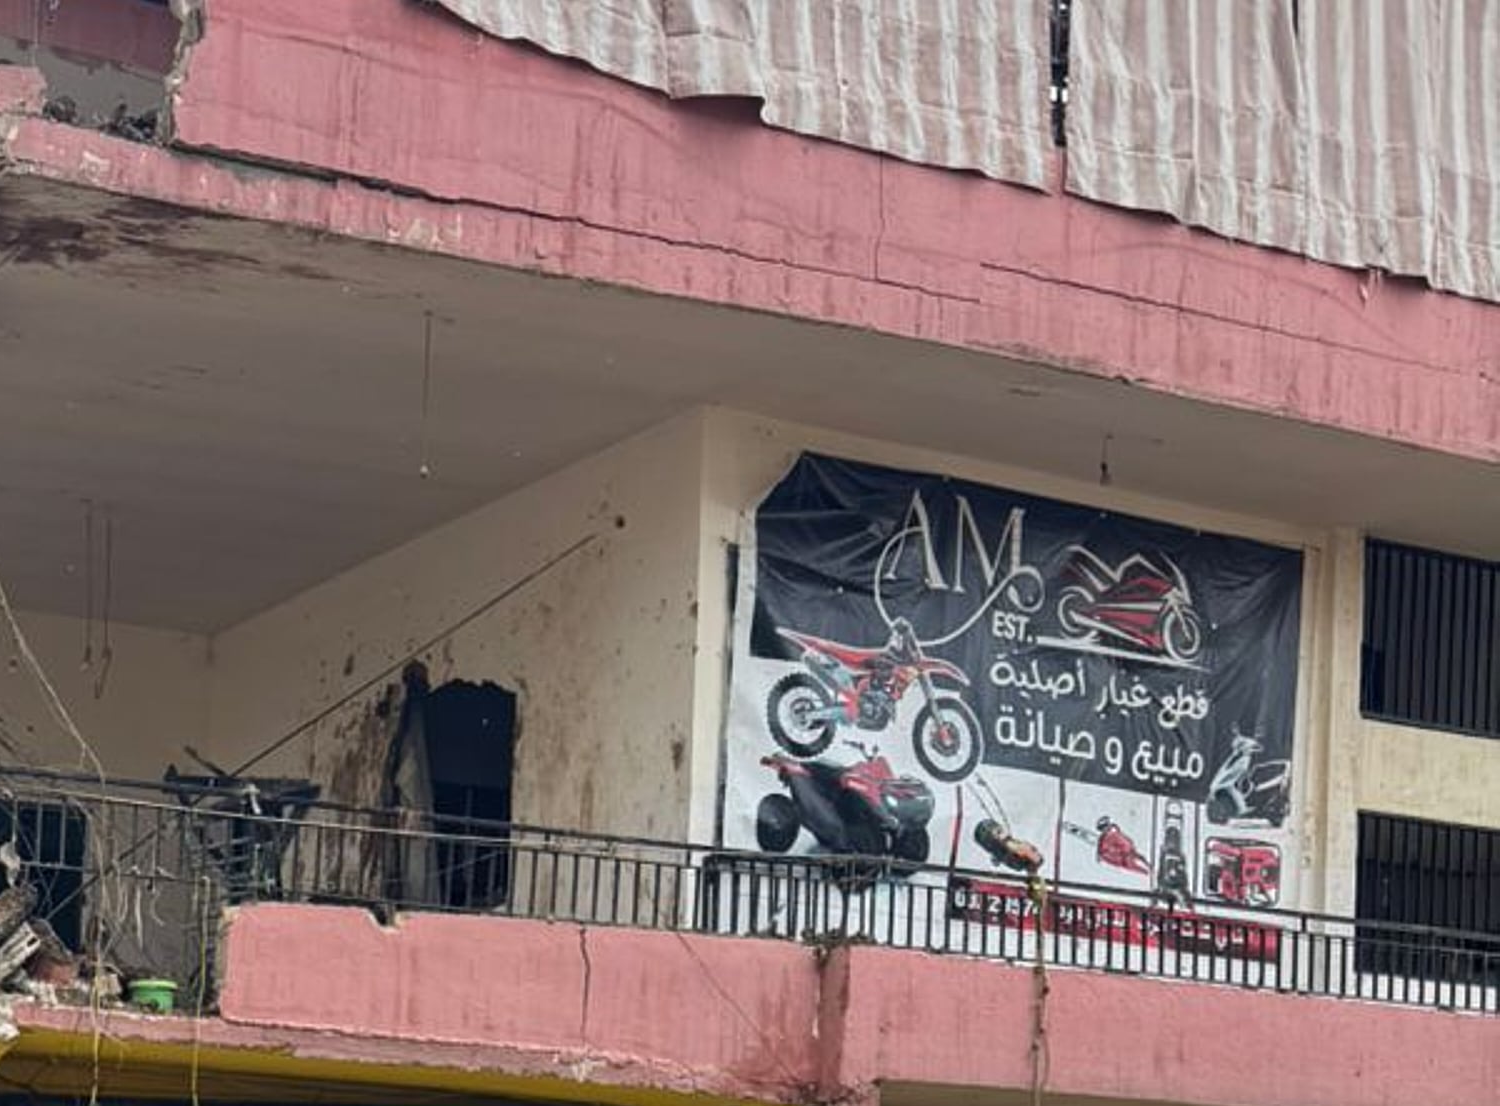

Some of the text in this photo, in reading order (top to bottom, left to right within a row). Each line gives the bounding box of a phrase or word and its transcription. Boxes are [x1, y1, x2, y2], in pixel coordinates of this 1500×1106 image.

[989, 652, 1210, 729] قطع غيار أصلية
[994, 703, 1205, 787] مبيع و صيانة
